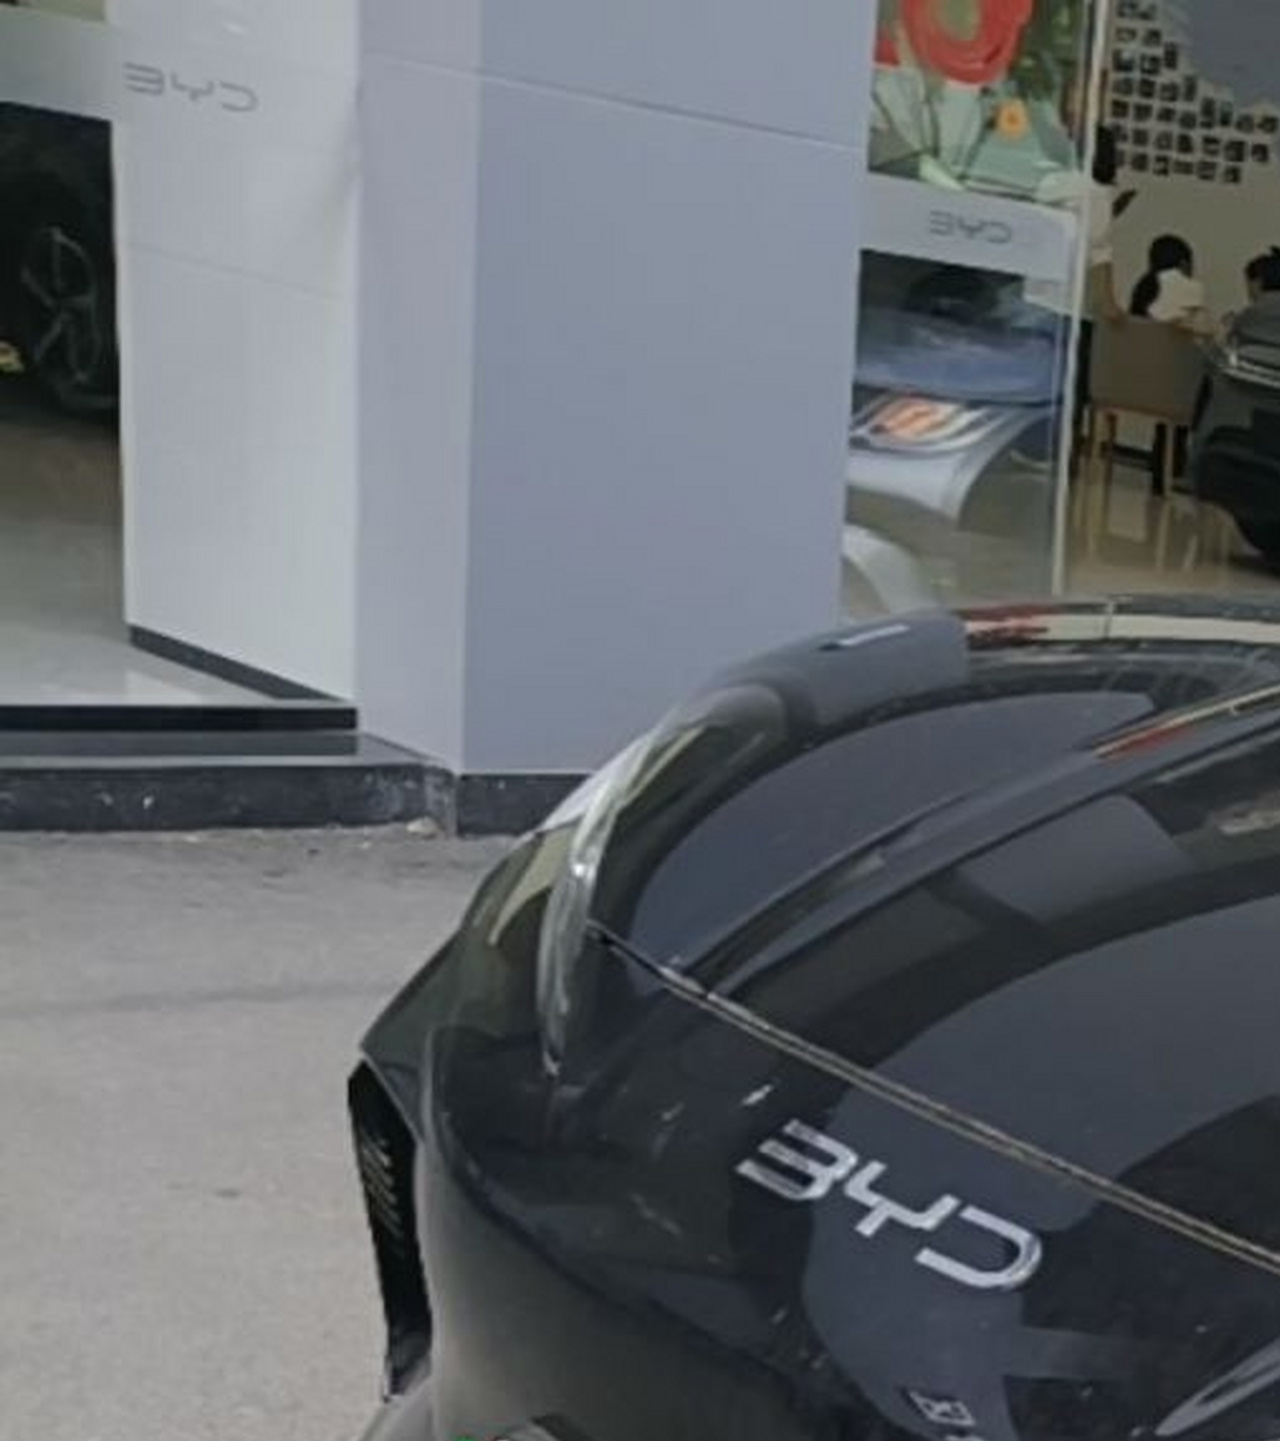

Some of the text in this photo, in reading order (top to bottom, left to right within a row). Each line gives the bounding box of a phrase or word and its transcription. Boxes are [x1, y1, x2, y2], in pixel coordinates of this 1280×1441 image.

[121, 61, 258, 112] BYD
[929, 209, 1012, 244] BYD
[735, 1118, 1042, 1288] BYD
